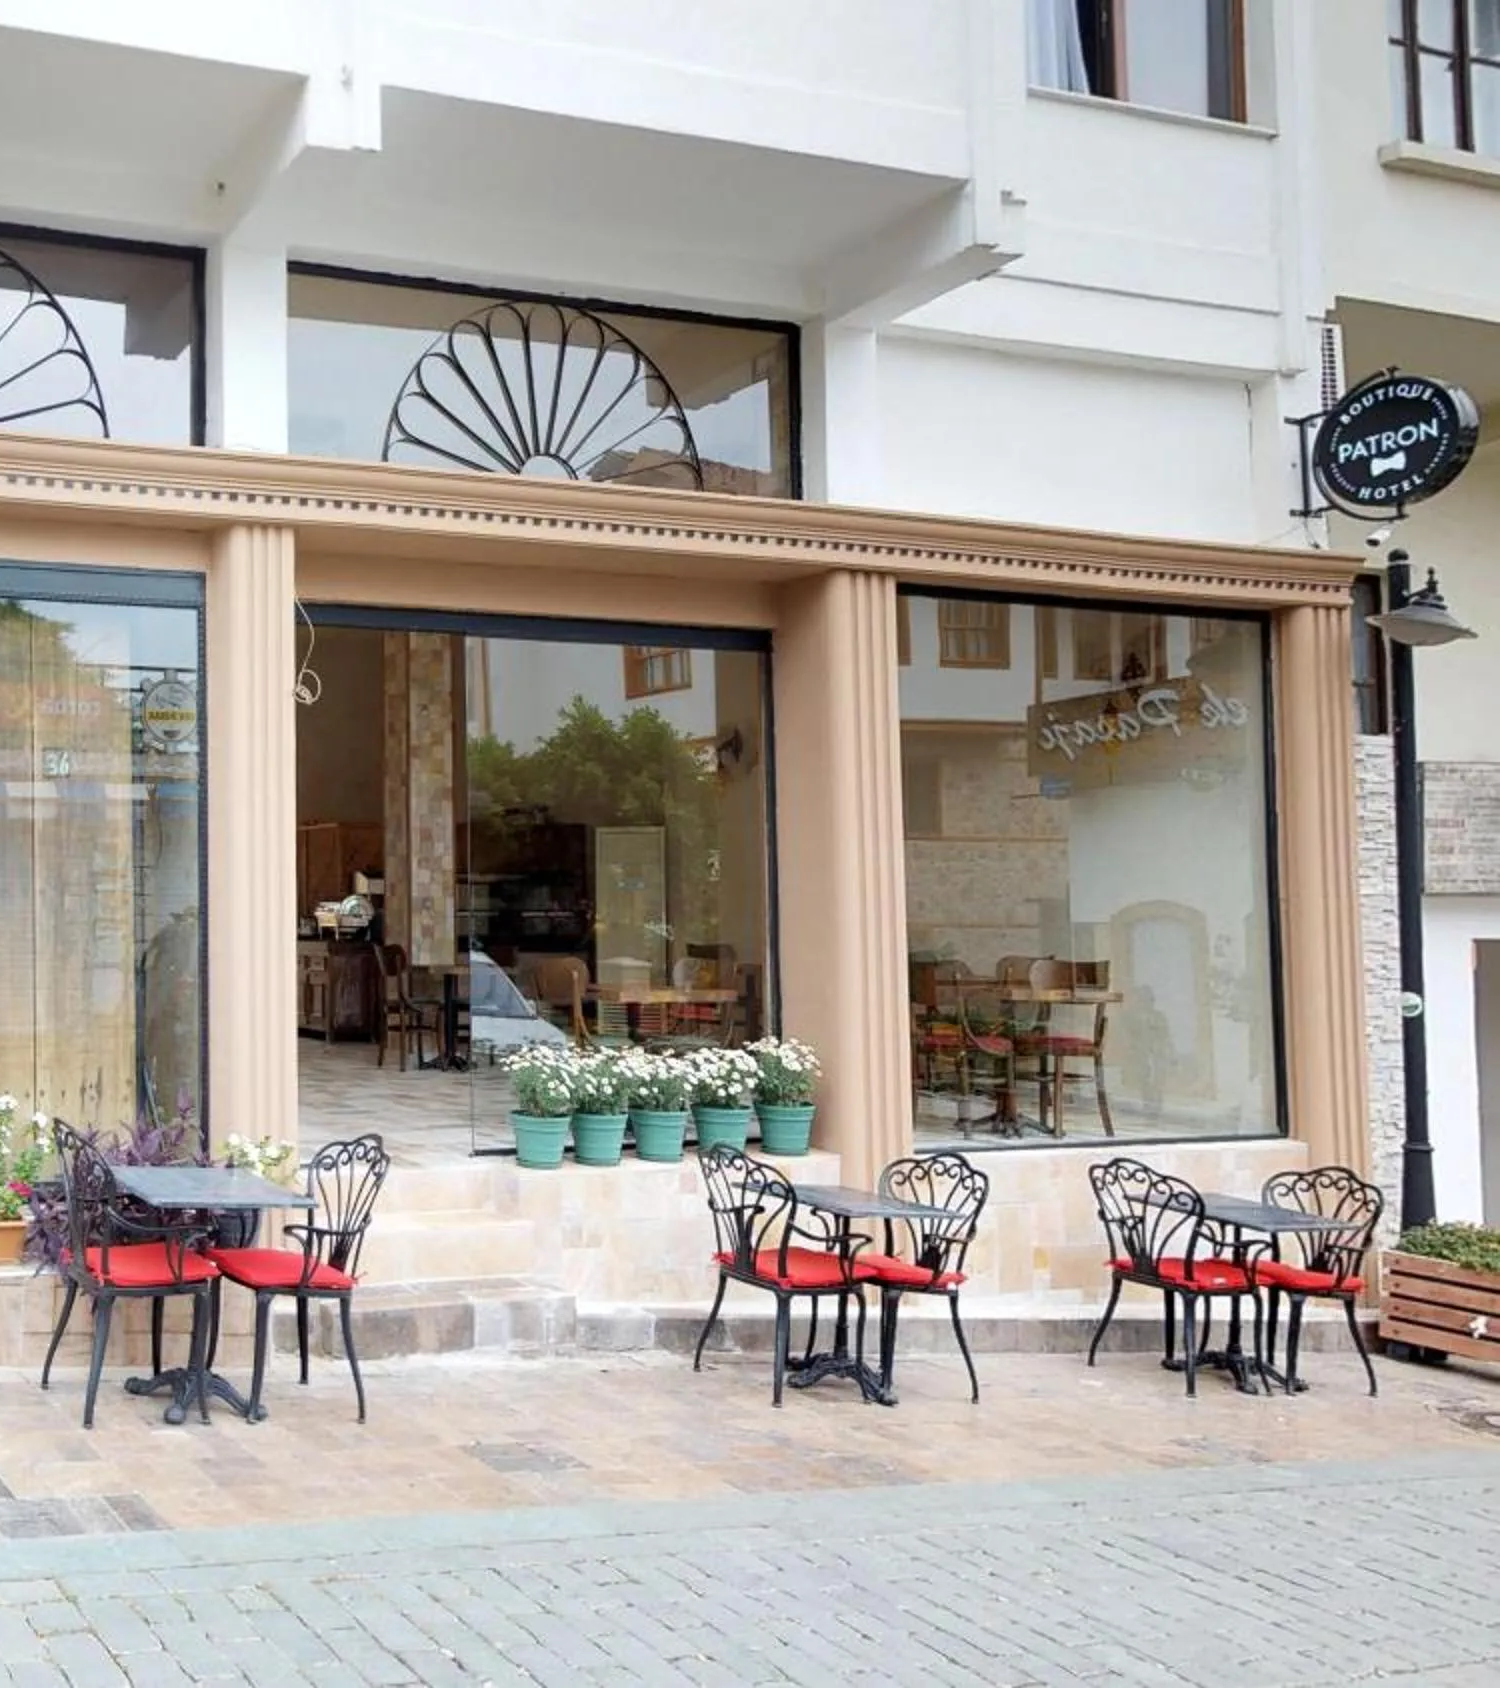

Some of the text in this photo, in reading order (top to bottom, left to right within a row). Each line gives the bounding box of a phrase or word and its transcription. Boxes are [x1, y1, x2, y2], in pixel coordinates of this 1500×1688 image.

[1339, 383, 1435, 425] BOUTIQUE
[1338, 417, 1439, 464] PATRON
[1357, 473, 1425, 500] HOTEL
